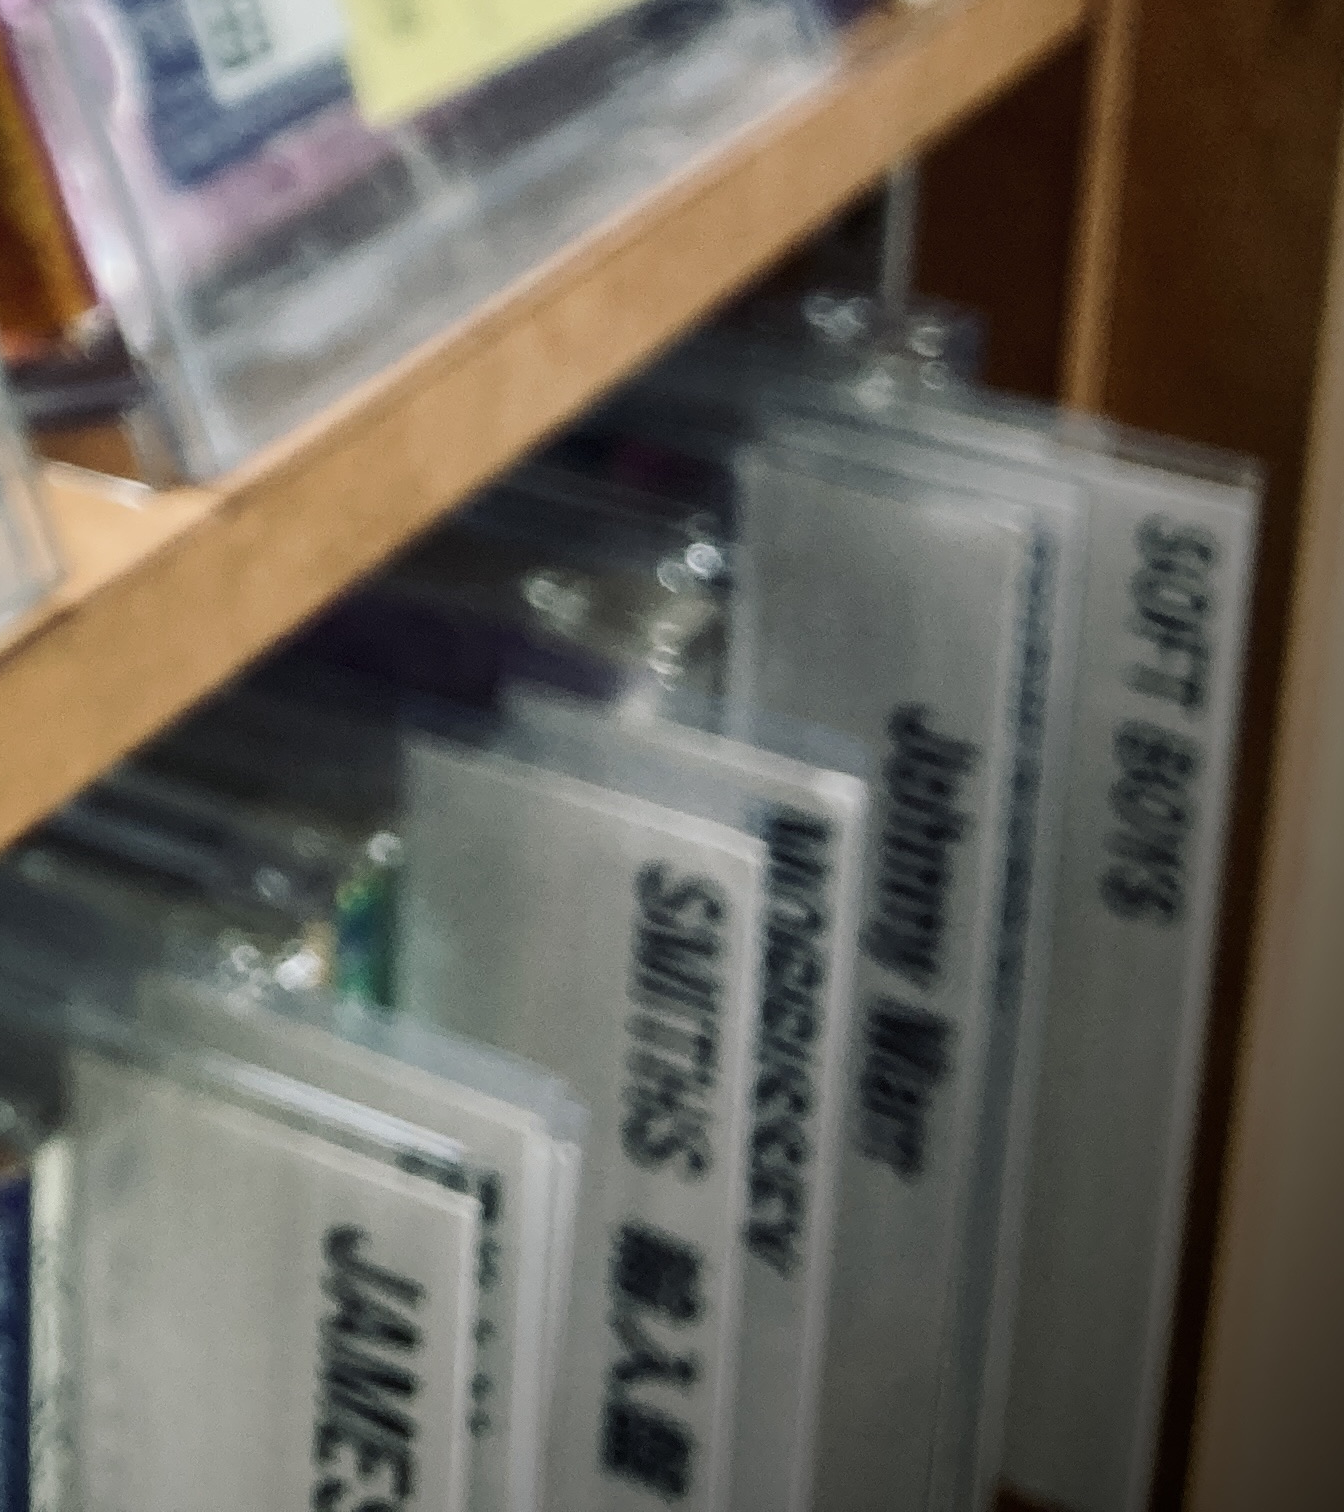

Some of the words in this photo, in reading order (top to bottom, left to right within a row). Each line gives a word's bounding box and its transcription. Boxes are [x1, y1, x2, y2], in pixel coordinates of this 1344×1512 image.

[1127, 510, 1217, 710] SOFT
[860, 701, 980, 986] Johnny
[1100, 718, 1196, 926] BOYS
[620, 858, 726, 1182] SMITHS
